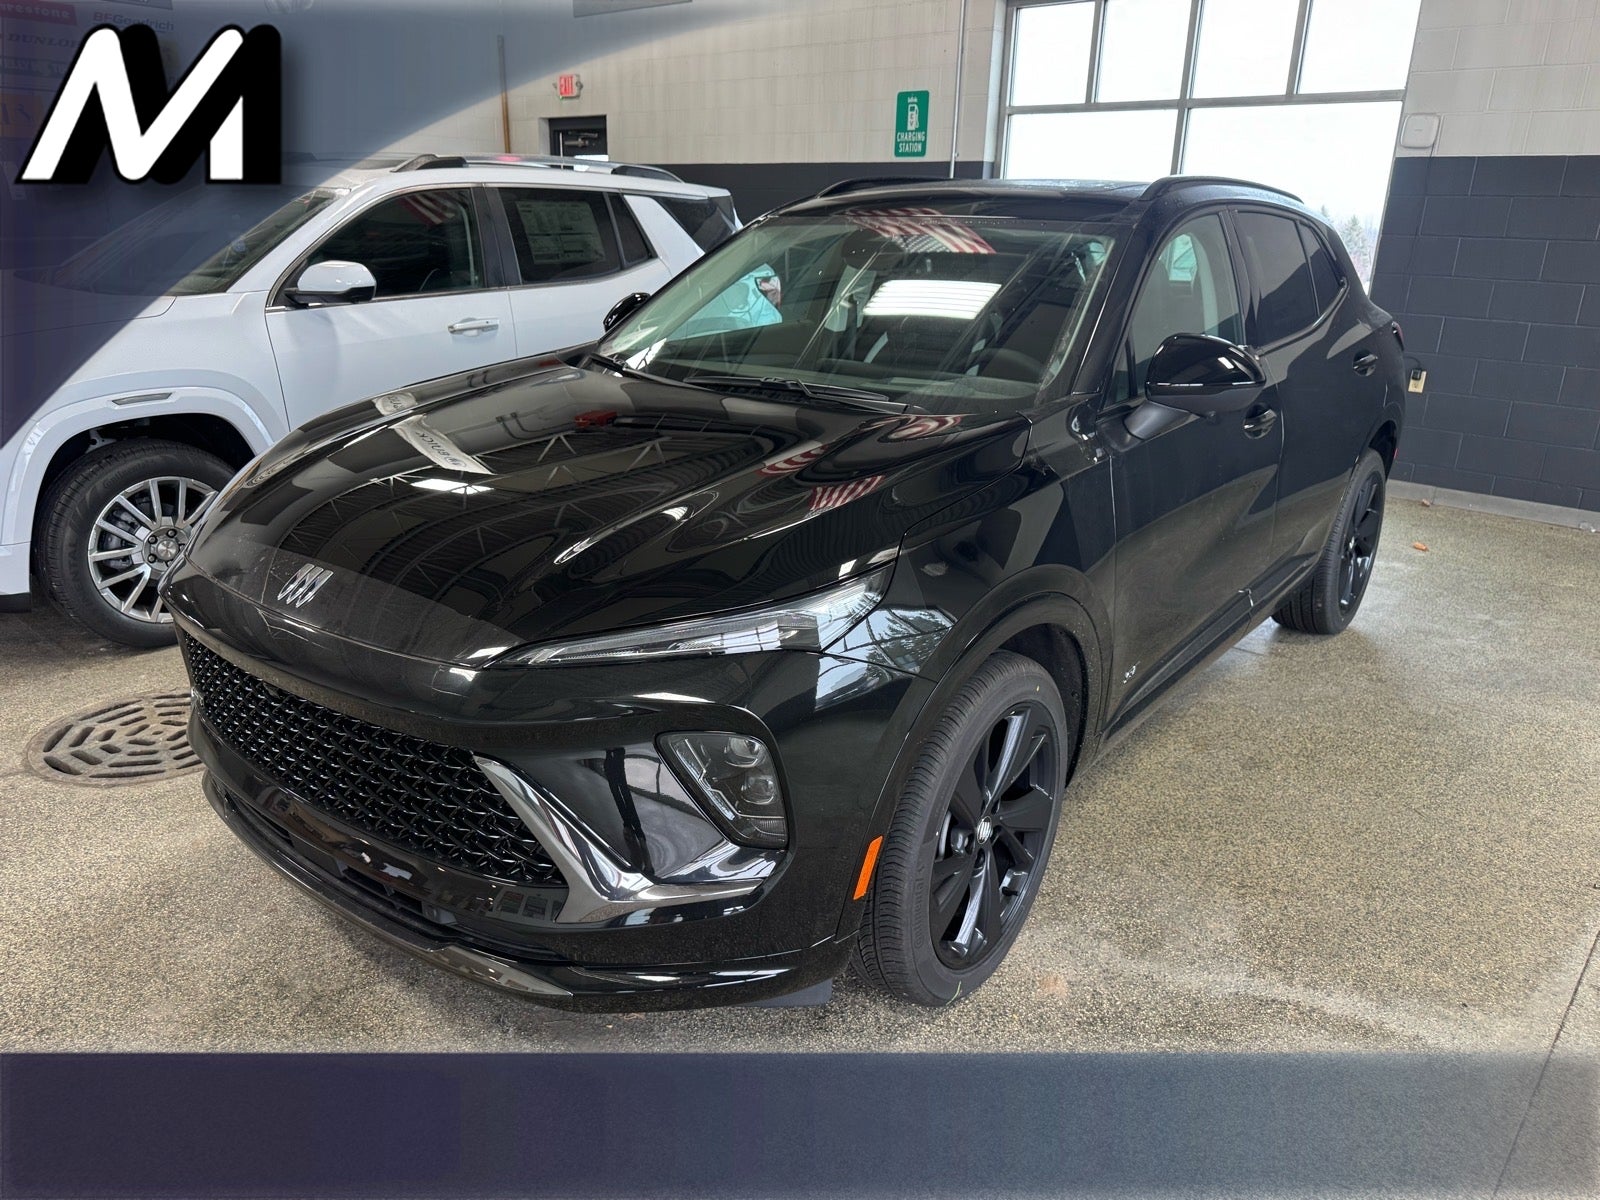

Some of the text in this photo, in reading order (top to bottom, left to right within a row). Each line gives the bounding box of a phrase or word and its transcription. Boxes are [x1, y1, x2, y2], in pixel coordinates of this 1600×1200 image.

[0, 3, 71, 19] irestone
[896, 132, 925, 142] CHARGING
[899, 143, 922, 152] STATION
